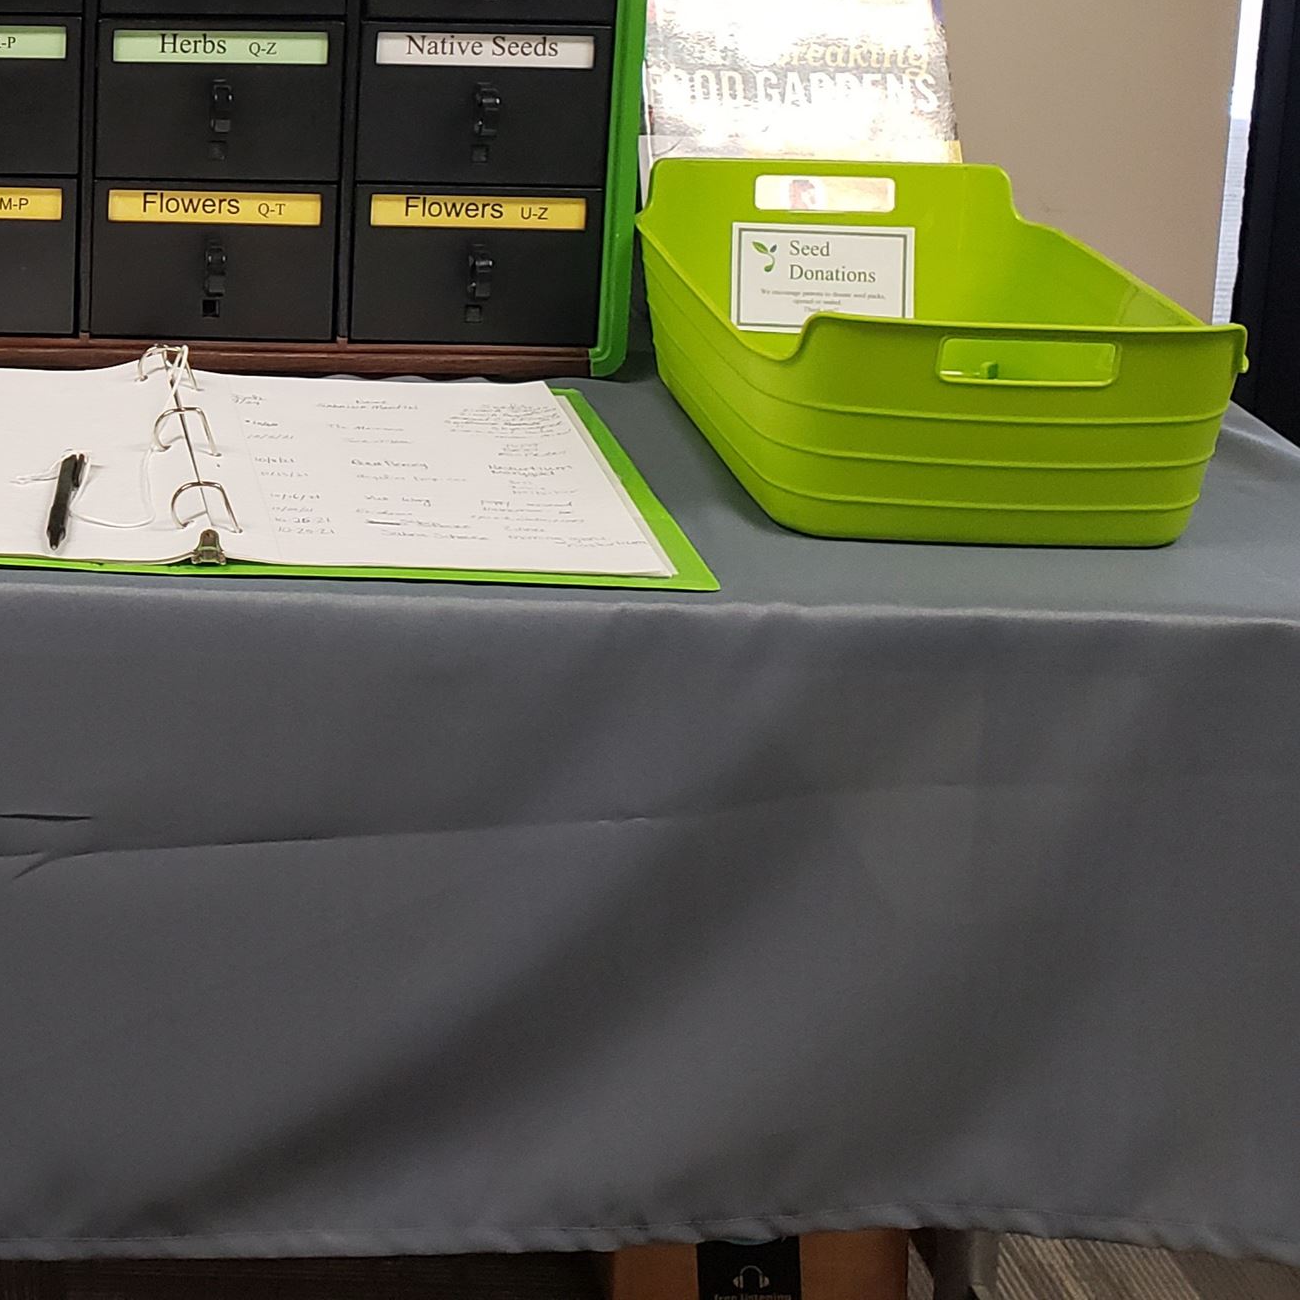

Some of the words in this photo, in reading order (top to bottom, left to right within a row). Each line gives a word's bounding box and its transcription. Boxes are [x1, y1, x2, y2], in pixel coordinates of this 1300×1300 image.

[159, 34, 227, 55] Herbs
[248, 42, 277, 56] Q-Z
[405, 35, 484, 58] Native
[491, 35, 559, 58] Seeds
[0, 197, 29, 211] M-P
[142, 192, 240, 216] Flowers
[257, 202, 287, 217] Q-T
[404, 196, 503, 220] Flowers
[520, 207, 549, 221] U-Z
[789, 240, 830, 257] Seed
[789, 265, 876, 283] Donations
